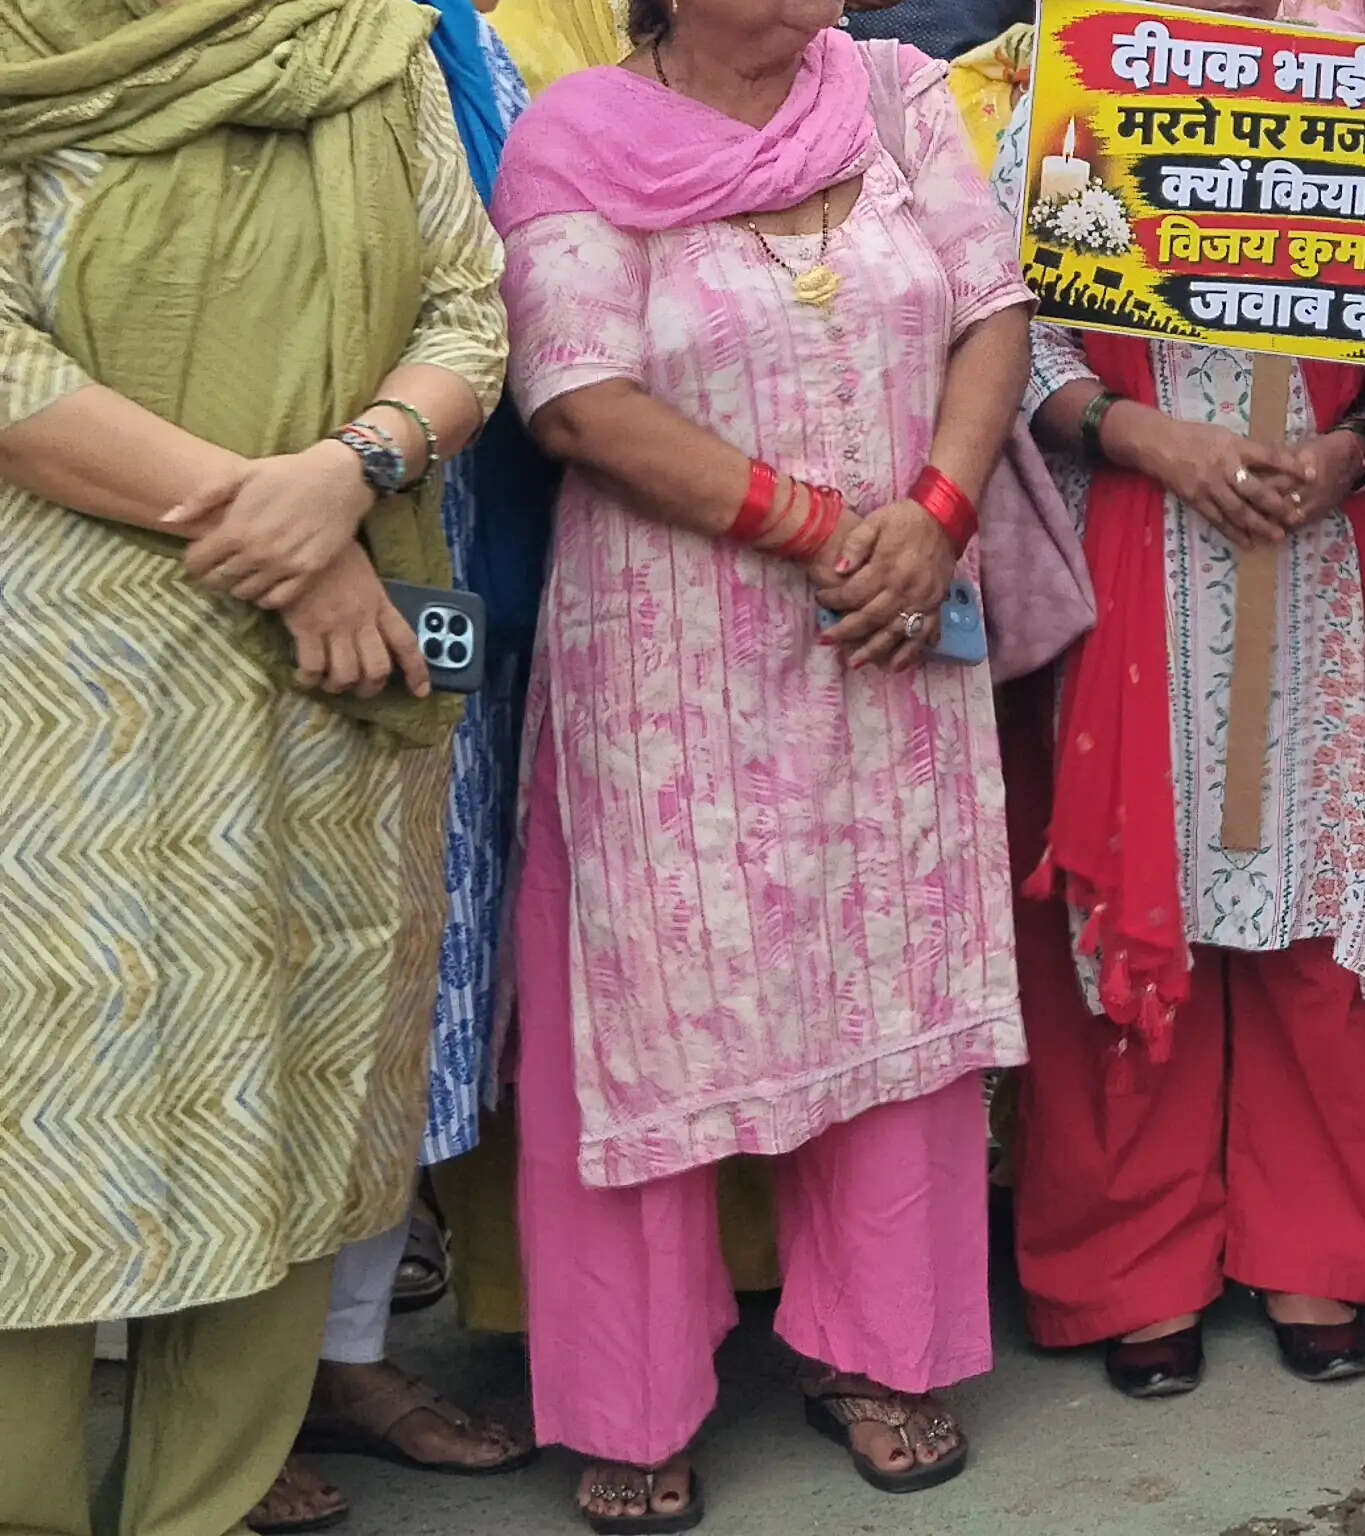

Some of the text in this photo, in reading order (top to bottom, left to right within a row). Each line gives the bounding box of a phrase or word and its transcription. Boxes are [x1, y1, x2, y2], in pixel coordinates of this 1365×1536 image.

[1112, 21, 1263, 91] दीपक
[1117, 97, 1221, 147] मरने
[1230, 112, 1290, 152] पर
[1161, 157, 1251, 210] क्यों
[1156, 217, 1279, 264] विजय
[1190, 280, 1333, 331] जवाब
